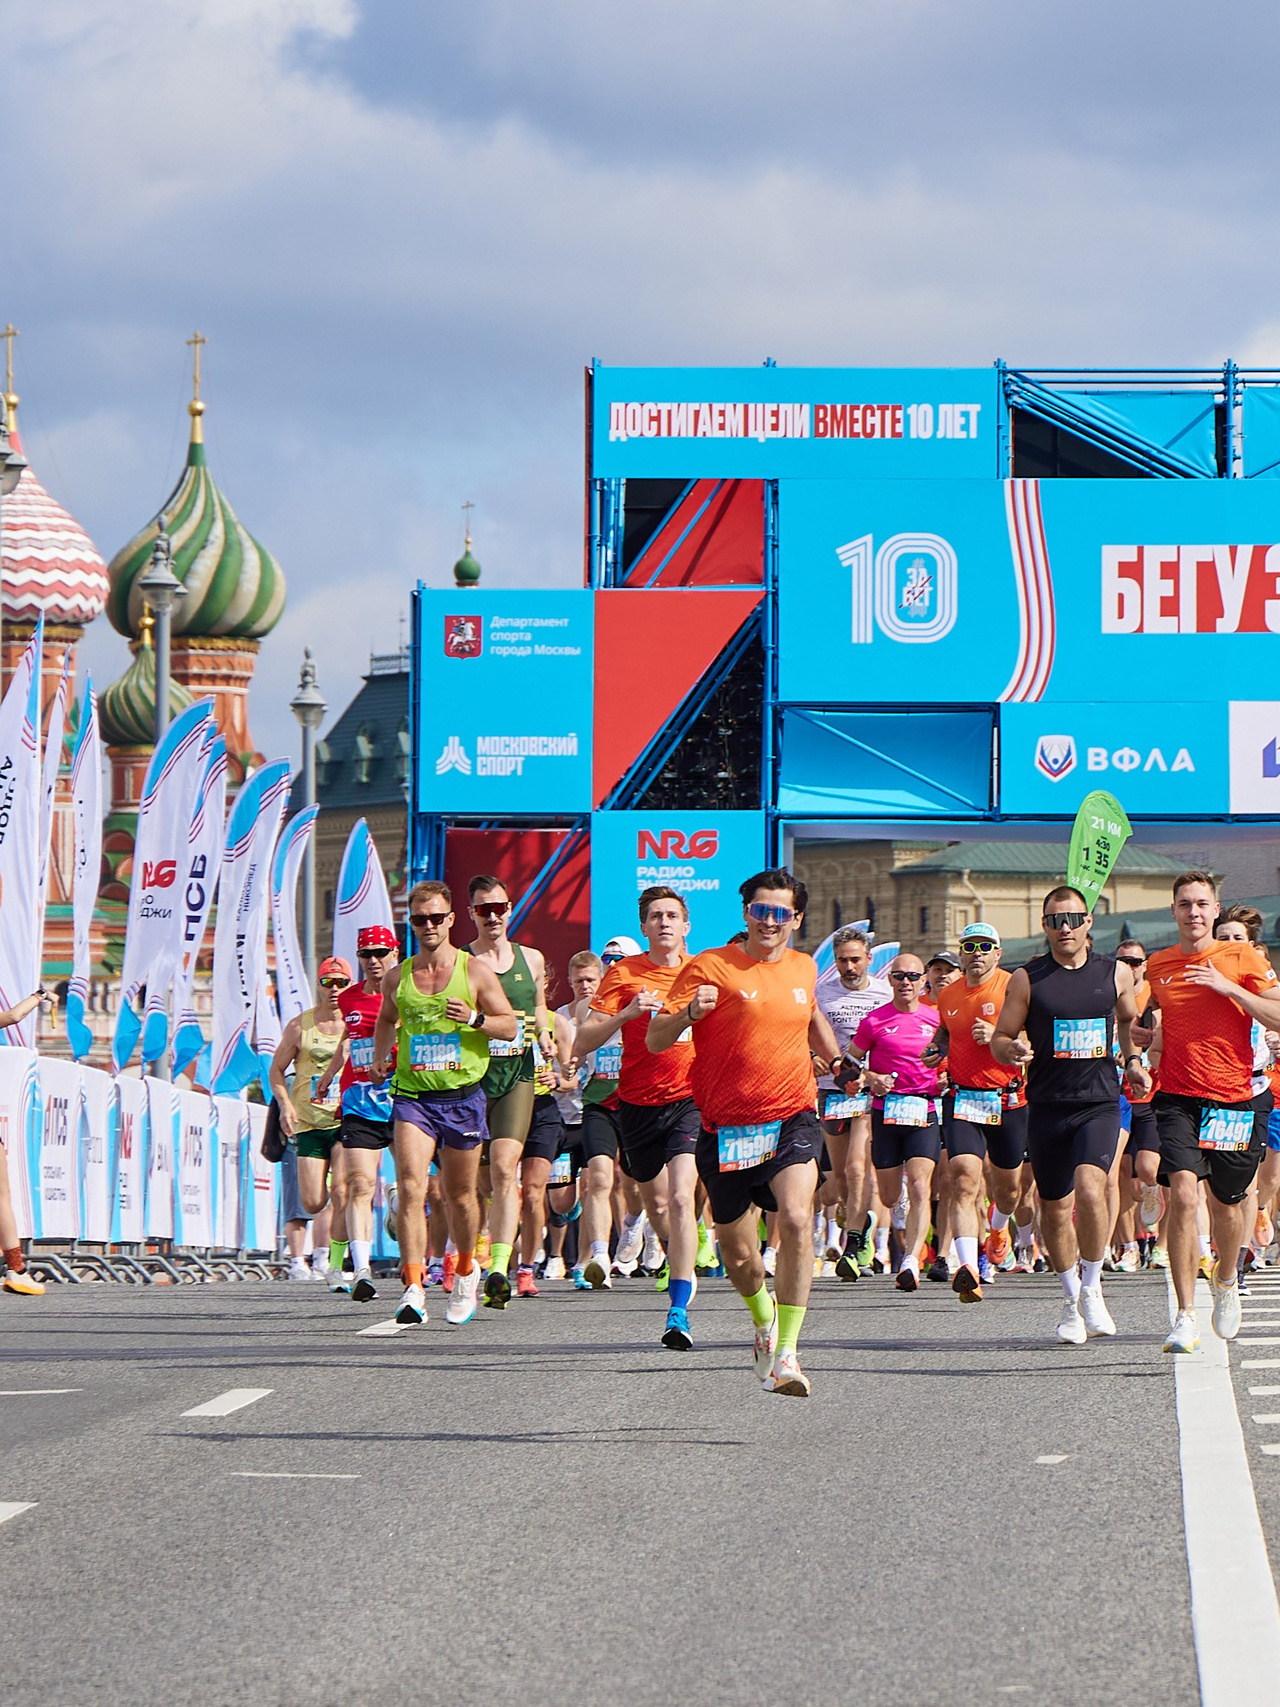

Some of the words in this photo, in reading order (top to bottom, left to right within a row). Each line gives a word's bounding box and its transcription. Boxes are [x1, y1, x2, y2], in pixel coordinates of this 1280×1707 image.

[609, 402, 743, 442] ДОСТИГАЕМ
[747, 403, 810, 443] ЦЕЛИ
[813, 404, 904, 439] ВМЕСТЕ
[906, 404, 934, 439] 10
[936, 403, 982, 439] ЛЕТ
[836, 533, 958, 643] 10
[1101, 544, 1252, 634] БЕГУ
[490, 616, 569, 629] Департамент
[490, 632, 532, 644] спорта
[490, 645, 532, 658] города
[533, 645, 581, 656] Москвы
[476, 732, 578, 756] МОСКОВСКИЙ
[476, 756, 525, 776] СПОРТ
[1087, 746, 1196, 773] ВФЛА
[1091, 815, 1104, 831] 21
[637, 829, 719, 860] NRG
[1095, 850, 1110, 869] 35
[636, 865, 695, 878] РАДИО
[791, 988, 808, 1004] 10
[980, 1002, 996, 1016] 10
[1059, 1030, 1102, 1049] 71826
[724, 1133, 776, 1161] 71590
